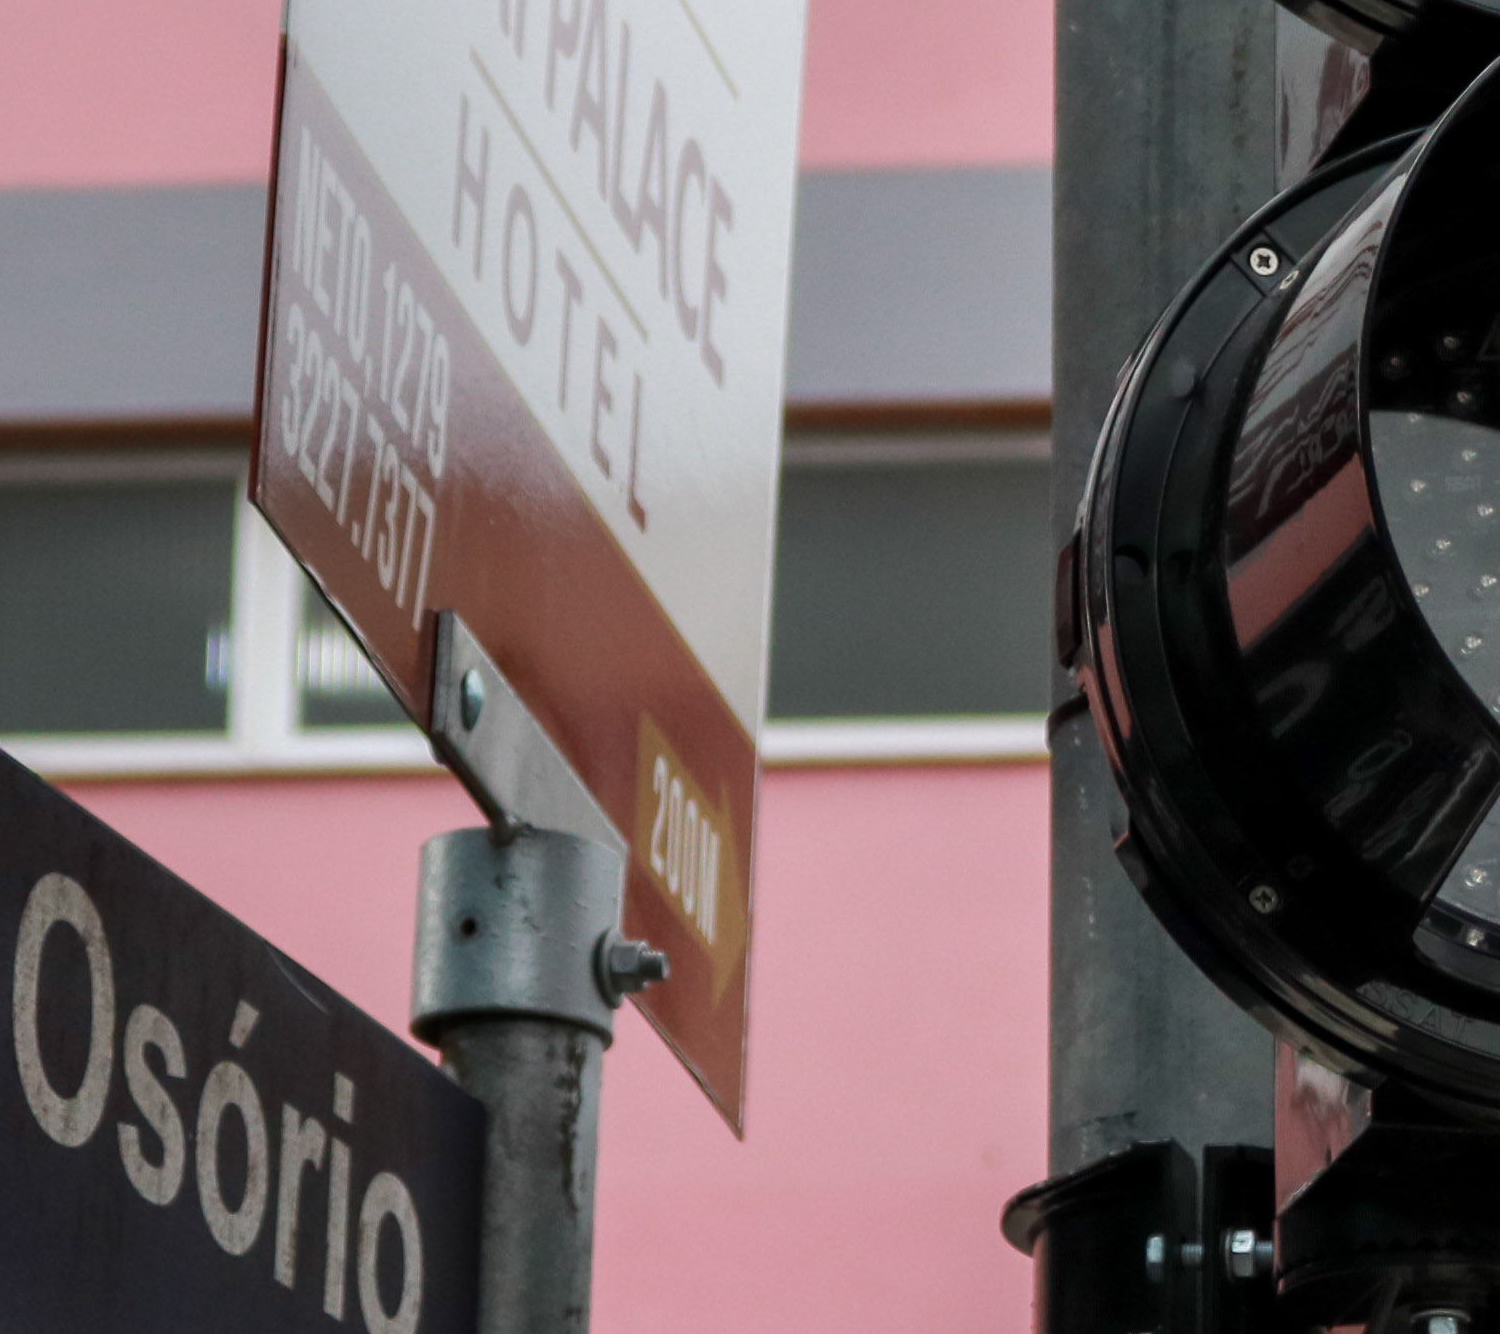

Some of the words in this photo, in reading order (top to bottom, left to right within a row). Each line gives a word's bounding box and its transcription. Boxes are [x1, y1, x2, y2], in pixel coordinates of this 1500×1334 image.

[281, 300, 437, 633] 3227.7377
[451, 91, 648, 535] HOTEL
[648, 751, 722, 944] 200M
